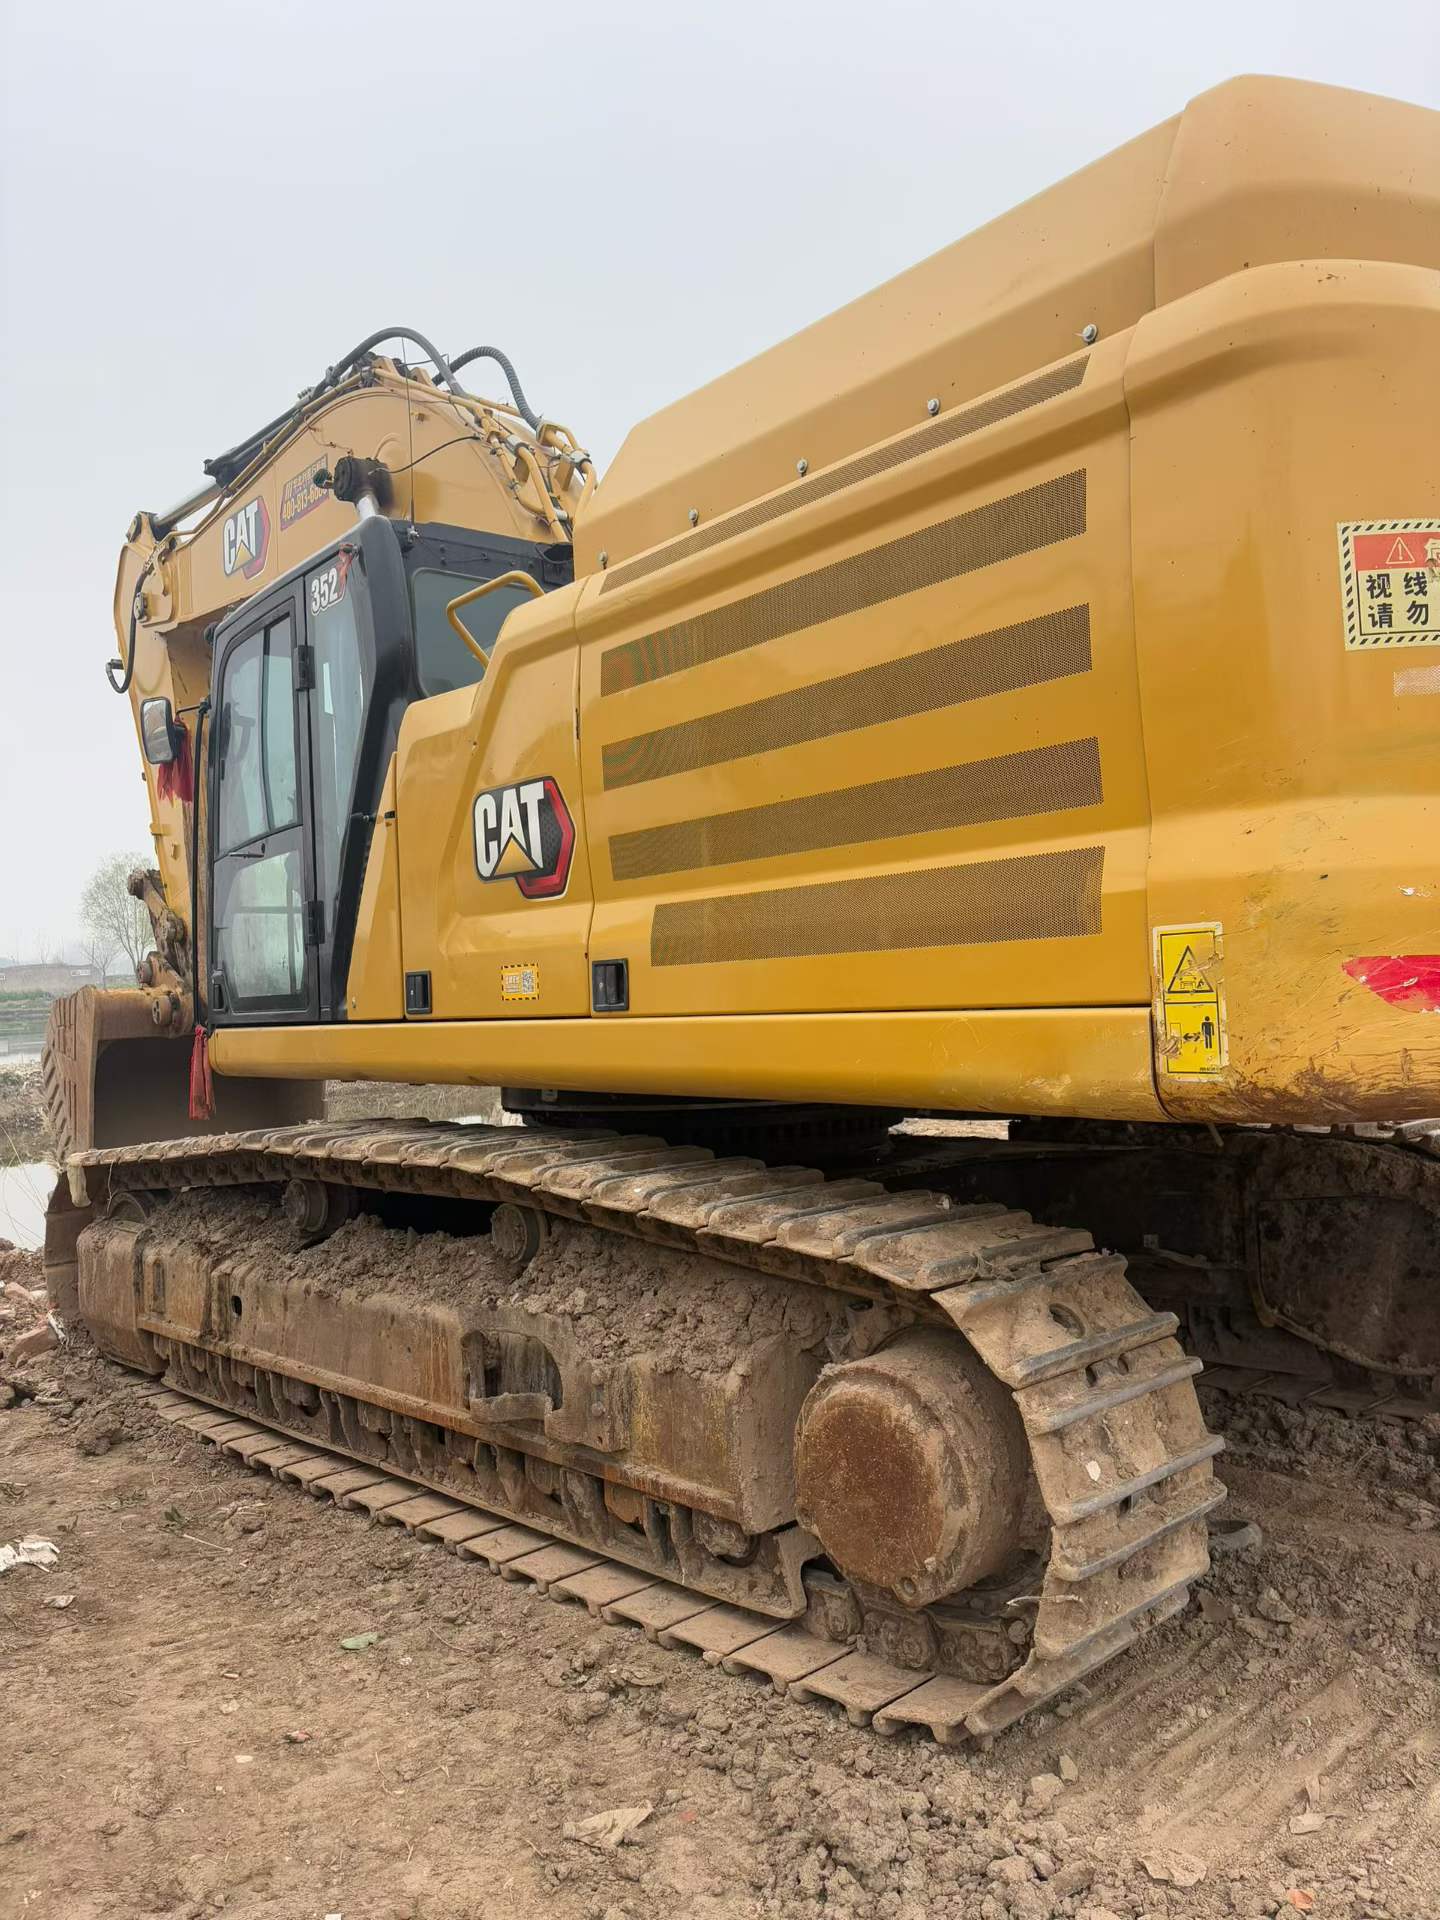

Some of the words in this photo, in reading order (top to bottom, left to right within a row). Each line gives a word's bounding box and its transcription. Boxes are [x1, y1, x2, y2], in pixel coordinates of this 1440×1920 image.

[224, 499, 259, 575] CAT
[311, 567, 339, 614] 352
[1366, 572, 1428, 599] 视线
[1368, 601, 1429, 628] 请勿
[474, 780, 545, 878] CAT
